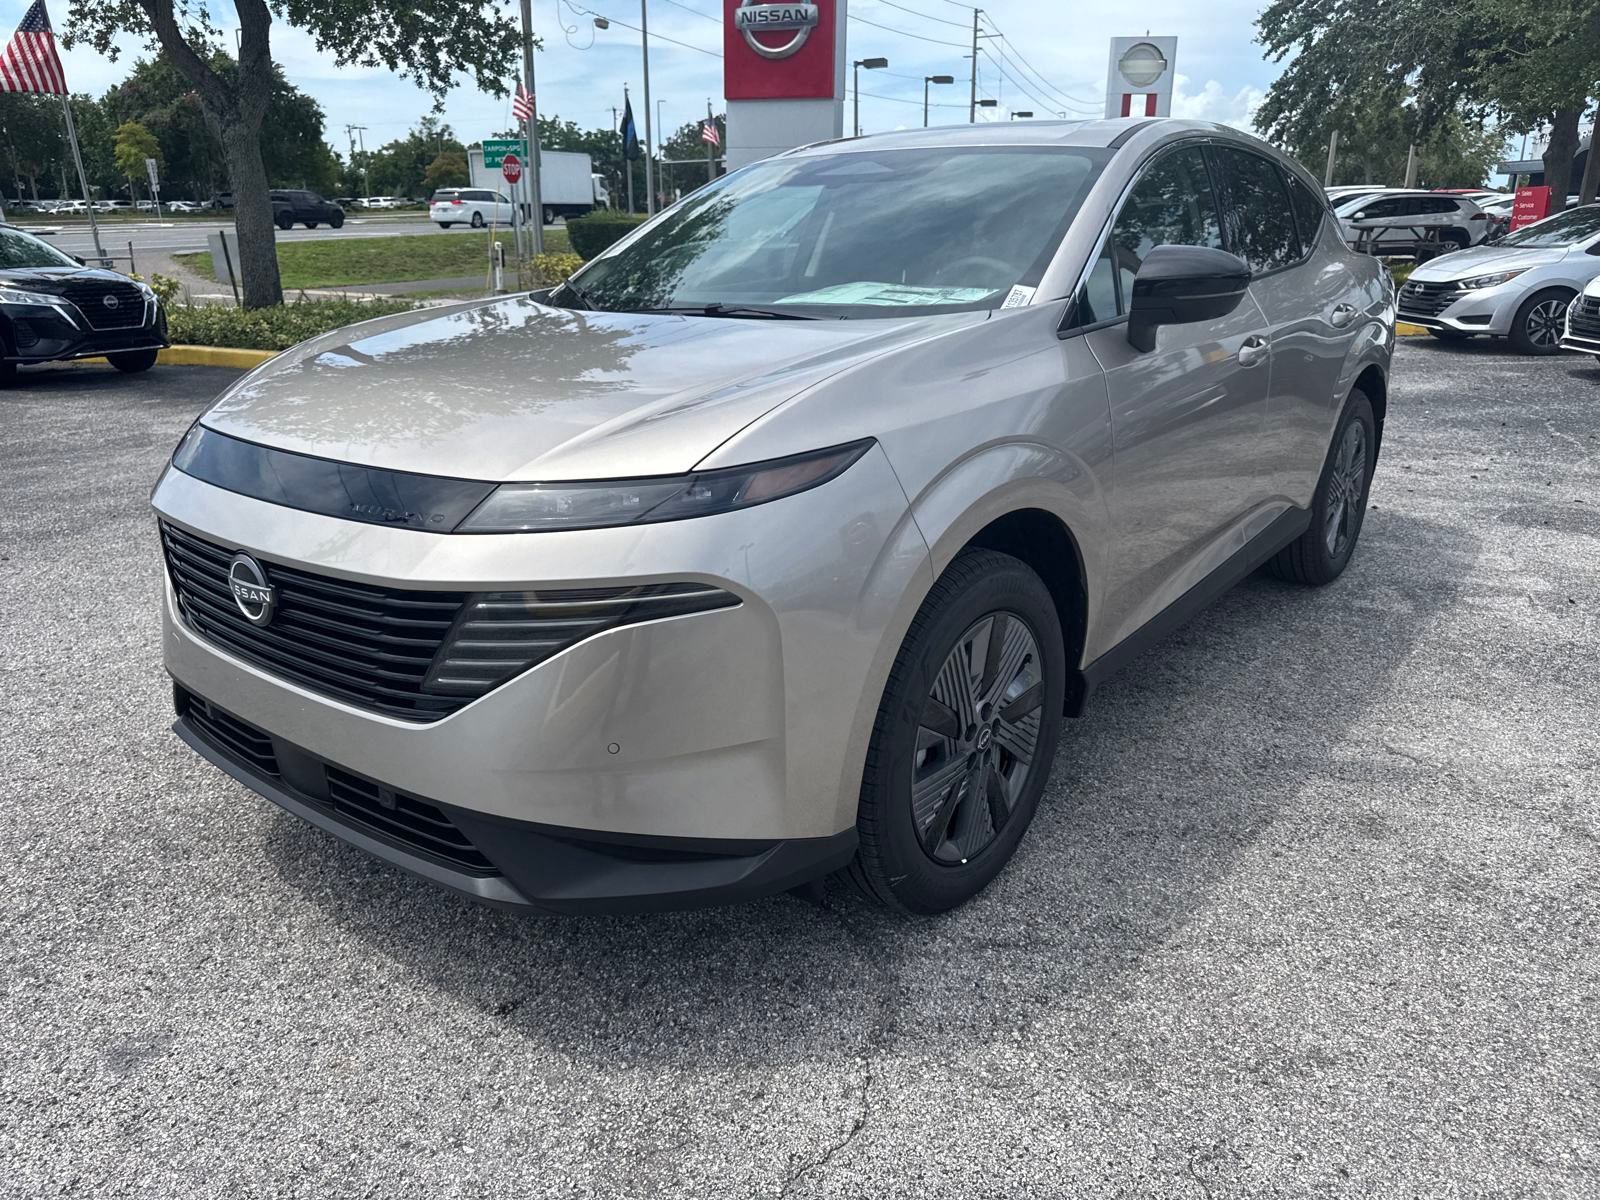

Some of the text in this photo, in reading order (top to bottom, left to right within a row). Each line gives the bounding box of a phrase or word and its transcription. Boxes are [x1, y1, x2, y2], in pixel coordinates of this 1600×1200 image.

[741, 8, 808, 24] NISSAN
[503, 163, 520, 176] STOP
[234, 584, 271, 602] SSAN
